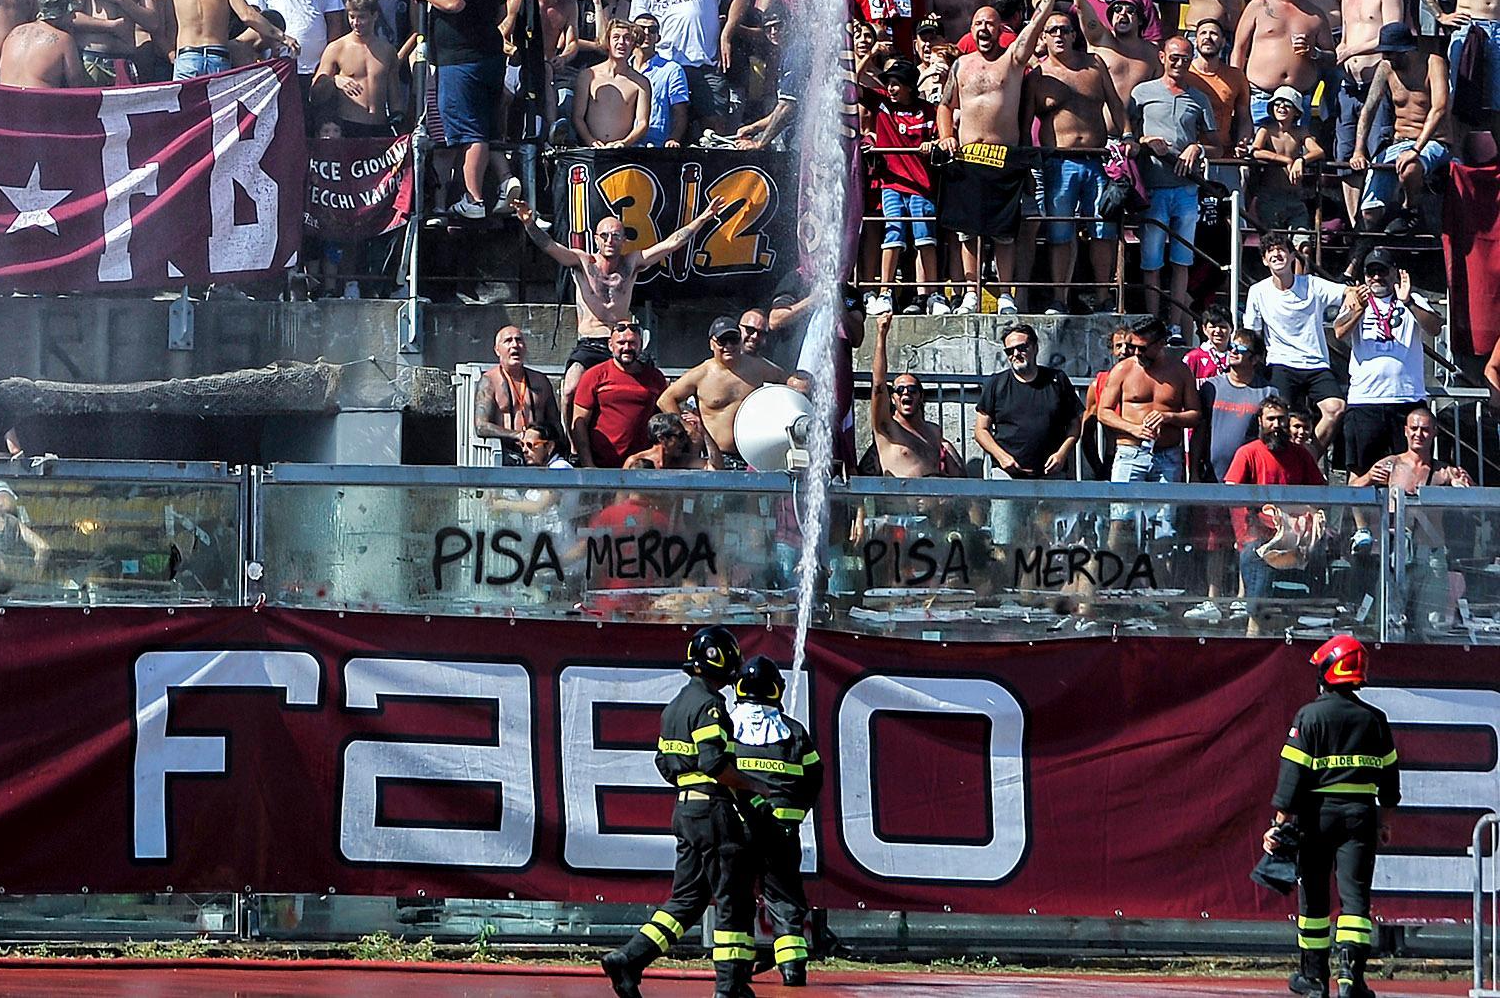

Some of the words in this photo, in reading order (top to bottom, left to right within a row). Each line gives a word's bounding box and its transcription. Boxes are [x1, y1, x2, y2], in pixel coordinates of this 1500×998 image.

[310, 185, 356, 210] ECCHI
[432, 526, 566, 590] PISA
[584, 527, 718, 582] MERDA
[862, 536, 970, 588] PISA
[1012, 546, 1158, 590] MERDA
[755, 759, 786, 771] FUOCO
[1338, 755, 1354, 767] DEL
